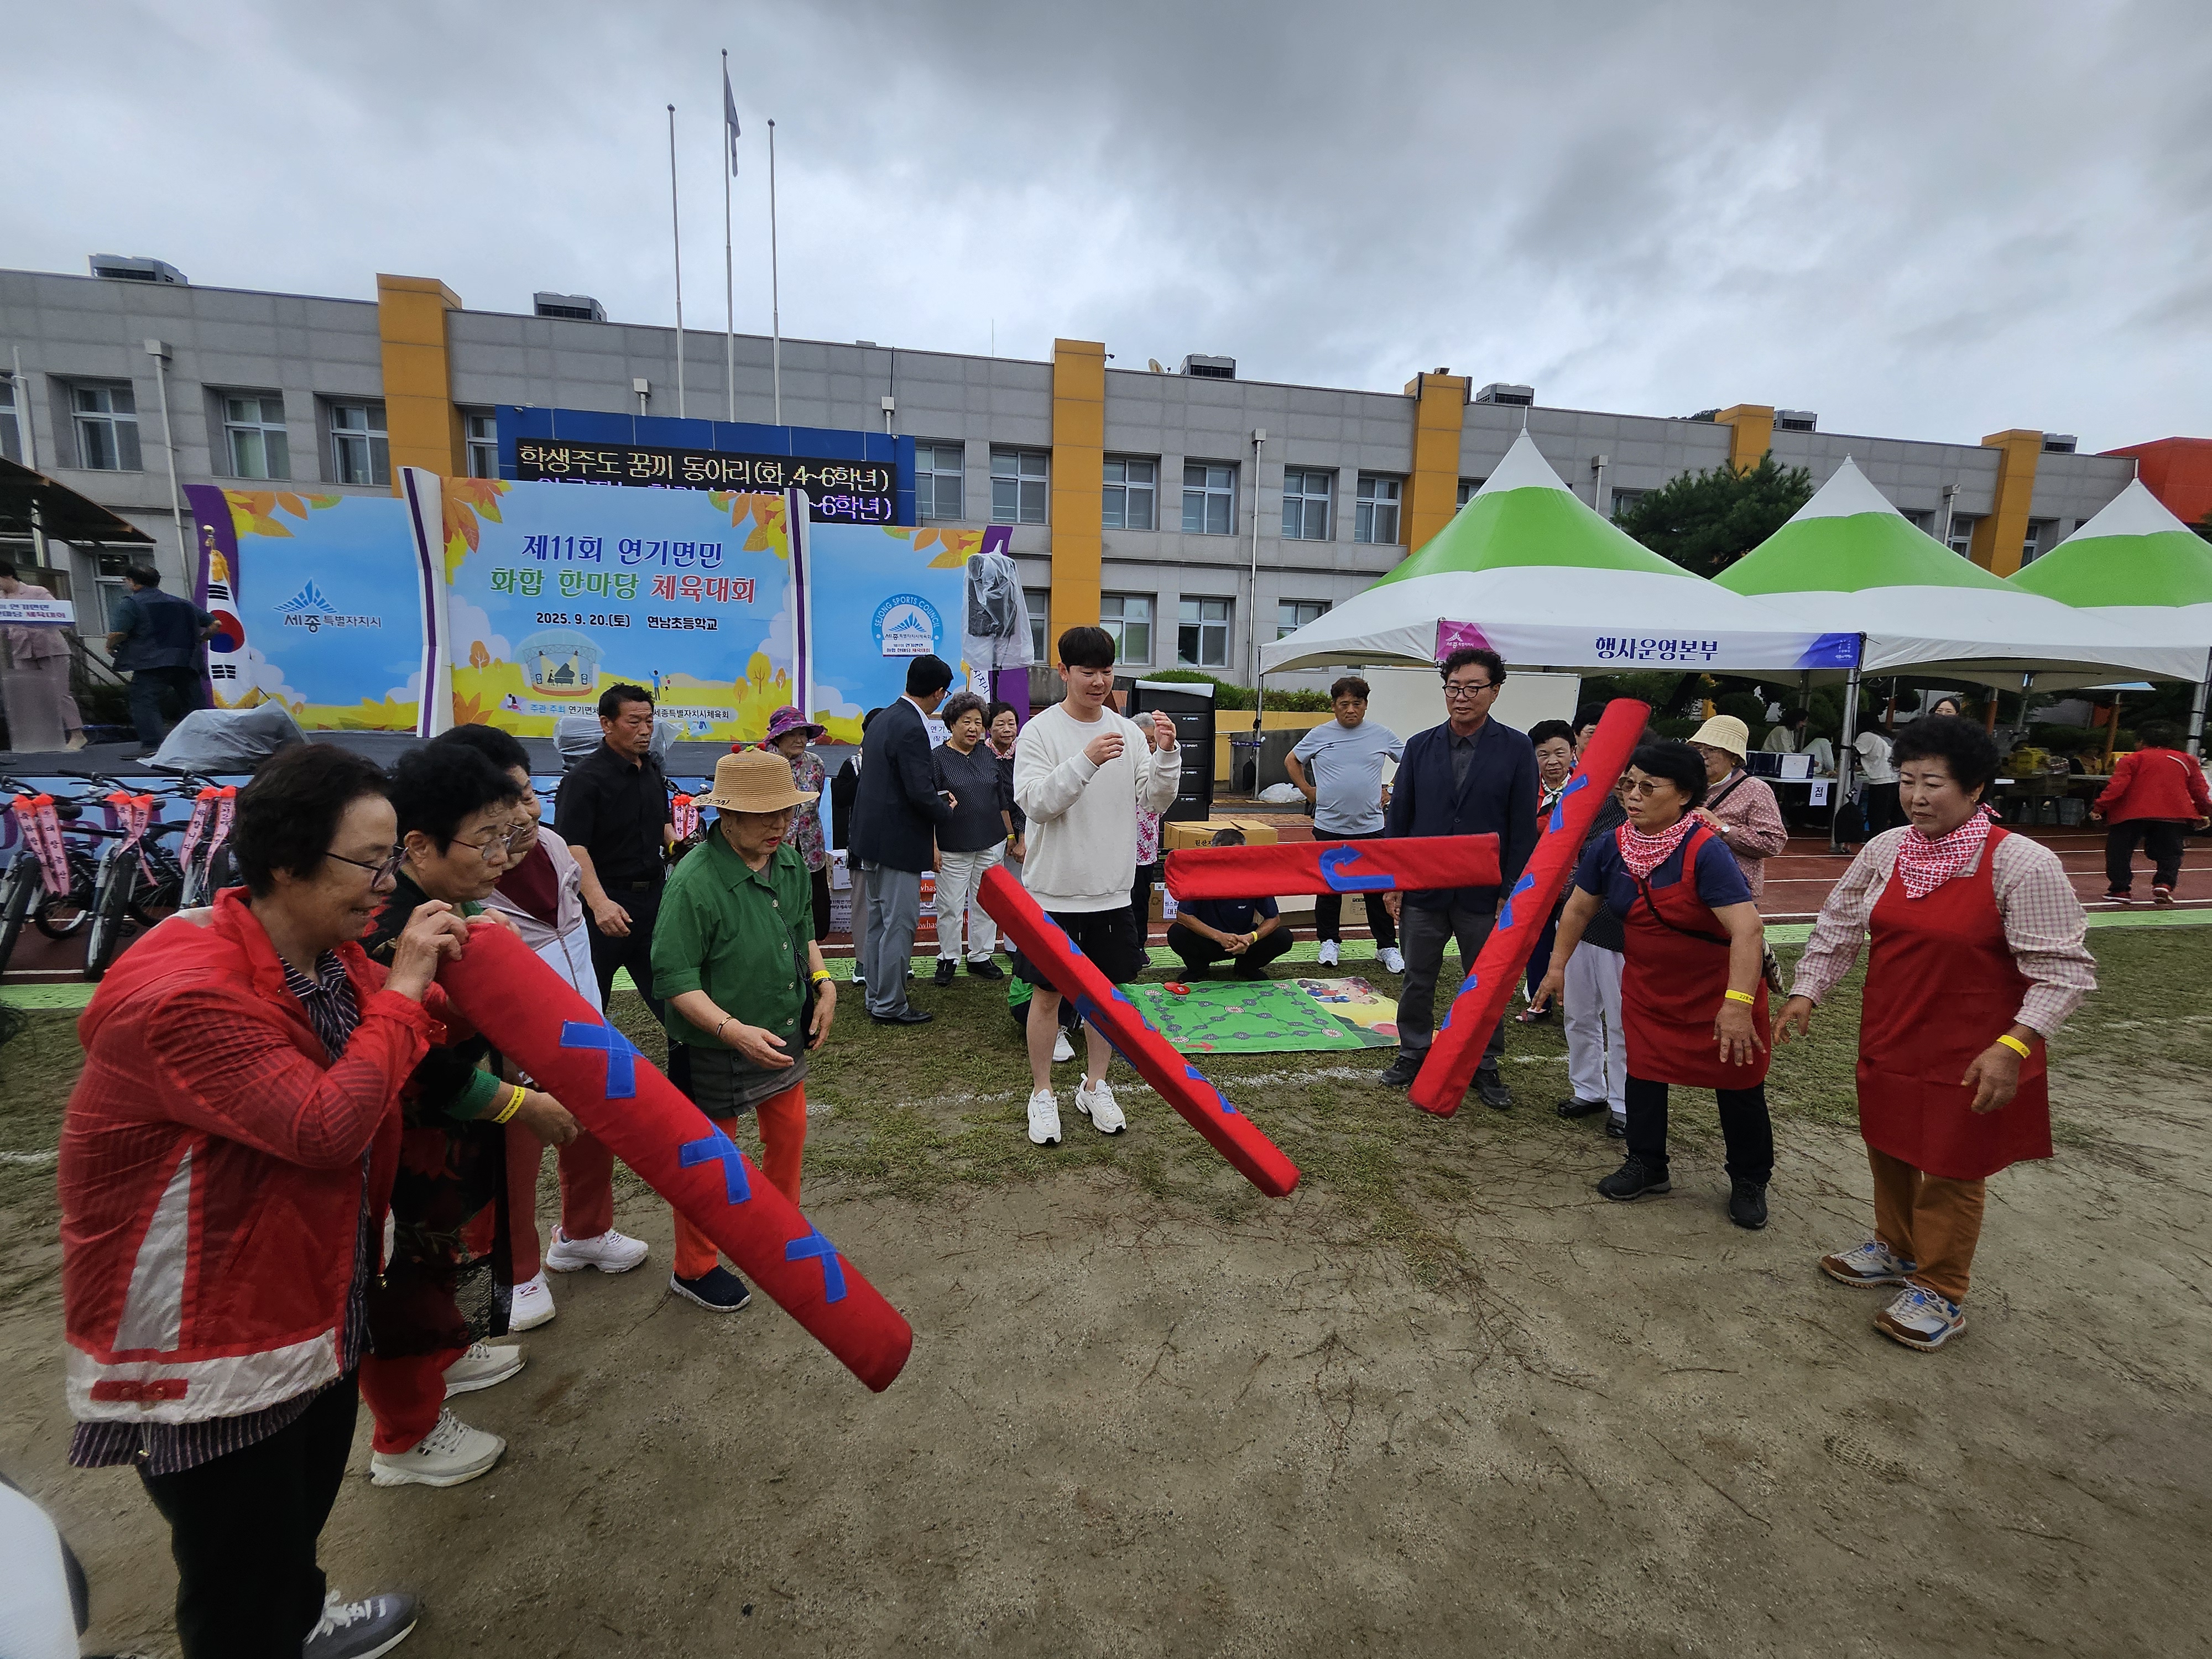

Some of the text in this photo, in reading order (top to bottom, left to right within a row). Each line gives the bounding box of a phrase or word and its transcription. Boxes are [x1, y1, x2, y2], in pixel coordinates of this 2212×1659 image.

[519, 446, 622, 474] 학생주도
[627, 452, 673, 479] 꿈끼
[521, 534, 724, 569] 제11회 연기면민
[490, 567, 756, 604] 화합 한마당 체육대회
[284, 614, 382, 633] 세종특별자치시
[536, 612, 718, 630] 2025. 9. 20.(토) 연남초등학교
[874, 596, 941, 629] SEJONG SPORTS COUNCIL
[1595, 637, 1719, 661] 행사운영본부
[654, 708, 729, 719] 세종특별자치시체육회
[1814, 786, 1824, 798] 접
